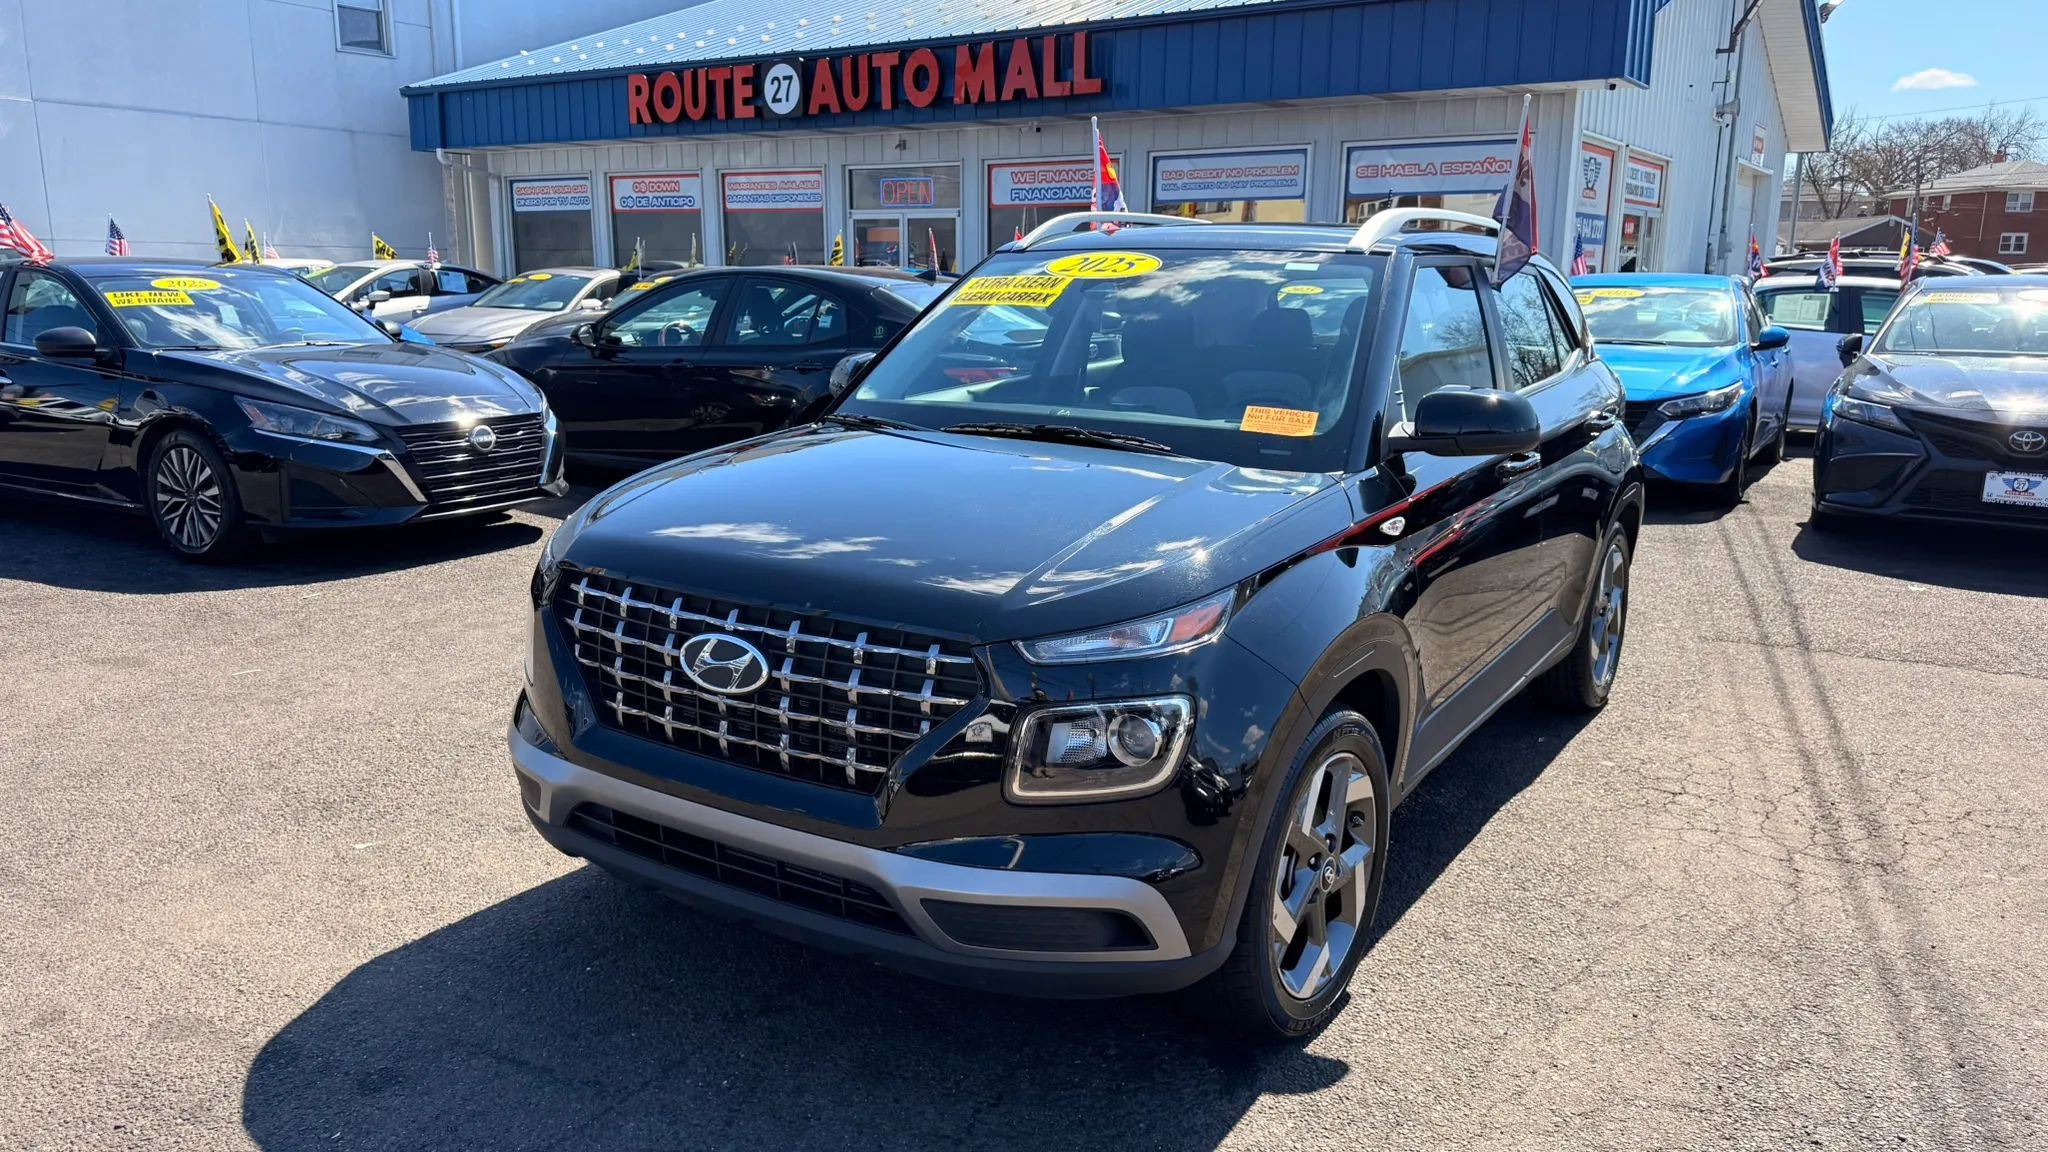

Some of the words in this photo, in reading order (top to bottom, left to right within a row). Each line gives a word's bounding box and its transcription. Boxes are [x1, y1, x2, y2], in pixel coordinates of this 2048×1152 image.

[628, 63, 756, 124] ROUTE
[770, 75, 793, 104] 27
[808, 48, 940, 115] AUTO
[953, 31, 1102, 105] MALL
[1011, 170, 1036, 184] WE
[1038, 169, 1095, 184] FINANCE
[1162, 170, 1185, 180] BAD
[1187, 169, 1223, 180] CREDIT
[1226, 168, 1243, 177] NO
[1244, 165, 1299, 177] PROBLEM
[1356, 165, 1379, 179] SE
[1381, 163, 1436, 178] HABLA
[516, 186, 535, 195] CASH
[536, 186, 550, 194] FOR
[551, 185, 571, 194] YOUR
[572, 185, 588, 193] CAR
[633, 181, 648, 194] 0$
[648, 181, 680, 193] DOWN
[728, 181, 777, 191] WARRANTIES
[778, 180, 820, 190] AVAILABLE
[1216, 181, 1230, 190] NO
[1231, 180, 1249, 189] HAY
[1250, 179, 1297, 189] PROBLEMA
[727, 194, 770, 203] GARANTIAS
[771, 193, 822, 203] DISPONIBLES
[883, 181, 932, 204] OPEN
[1011, 187, 1094, 200] FINANCIAMO
[516, 198, 542, 207] DINERO
[542, 198, 558, 207] POR
[559, 197, 569, 206] TU
[570, 196, 591, 206] AUTO
[620, 197, 634, 210] 0$
[635, 197, 649, 208] DE
[650, 195, 695, 208] ANTICIPO
[375, 240, 398, 259] SALE
[1061, 257, 1147, 273] 2025
[167, 280, 208, 288] 2025
[969, 277, 1014, 290] EXTRA
[1015, 277, 1067, 291] CLEAN
[956, 291, 999, 303] CLEAN
[999, 291, 1059, 304] CARFAX
[1265, 414, 1285, 422] FOR
[1288, 416, 1313, 424] SALE
[1273, 409, 1313, 418] VEHICLE
[2015, 482, 2026, 490] 27
